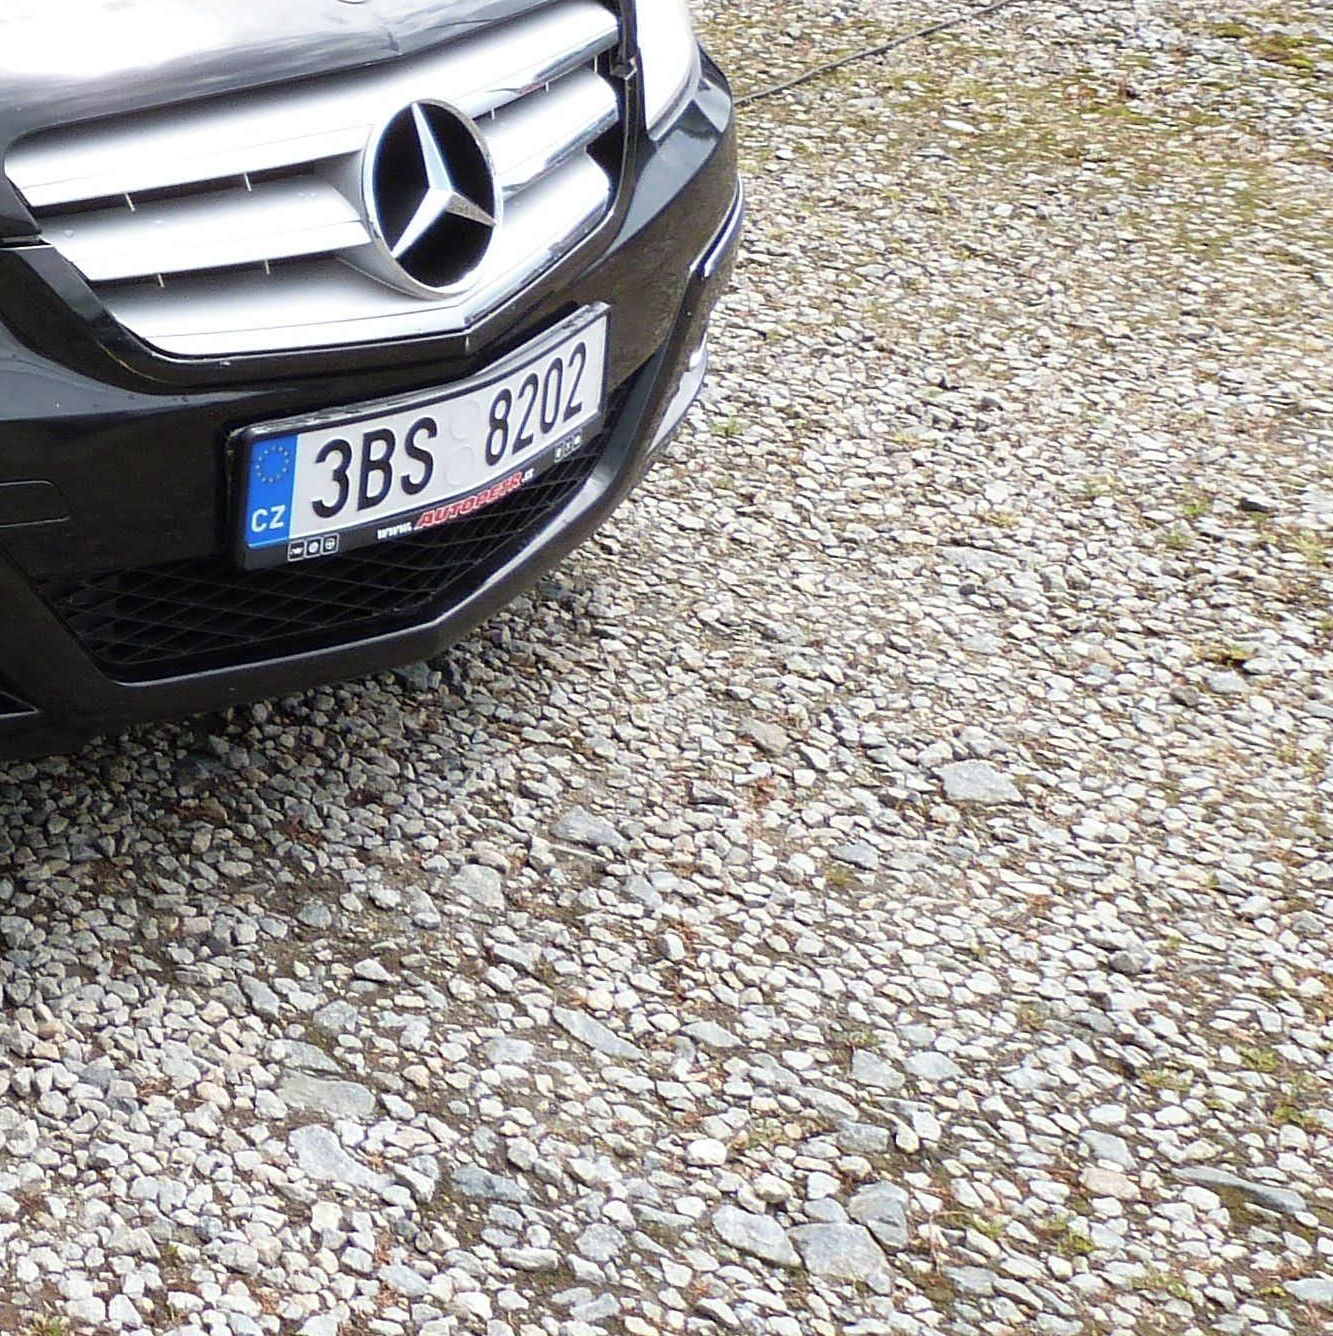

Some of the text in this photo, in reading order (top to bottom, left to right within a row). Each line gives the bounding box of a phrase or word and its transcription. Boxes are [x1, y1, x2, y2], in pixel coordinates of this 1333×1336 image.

[311, 341, 587, 519] 3BS 8202
[251, 504, 286, 533] CZ
